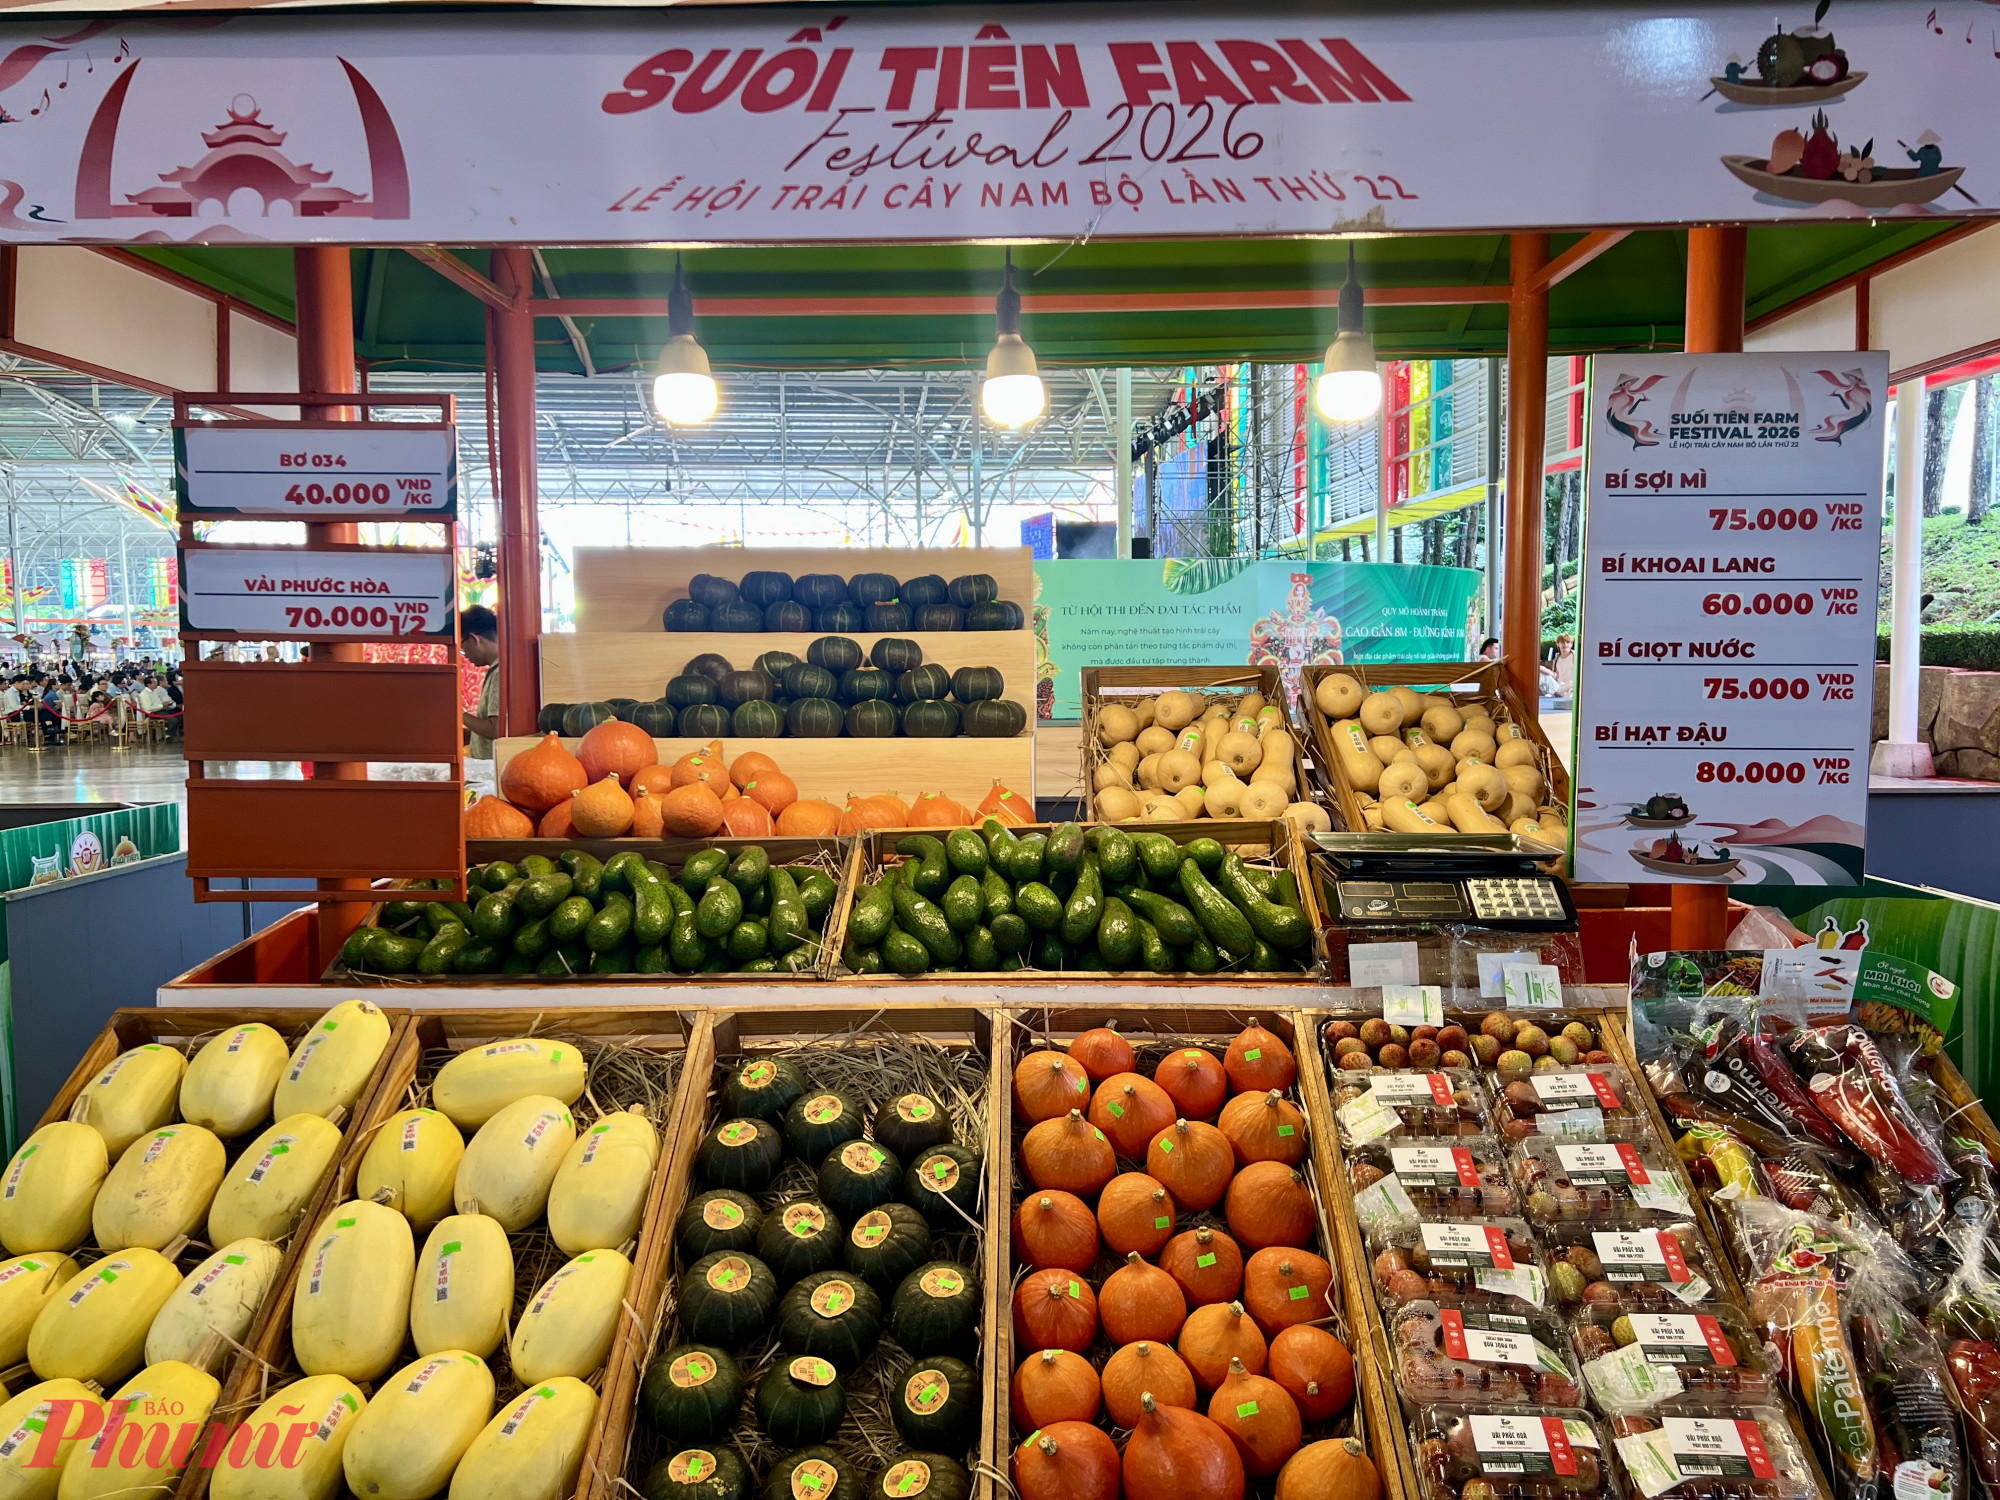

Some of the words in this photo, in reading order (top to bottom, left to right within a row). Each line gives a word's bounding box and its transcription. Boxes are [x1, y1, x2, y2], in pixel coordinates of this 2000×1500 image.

[601, 16, 854, 115] SUỐI
[879, 24, 1091, 112] TIÊN
[1107, 37, 1414, 106] FARM
[784, 106, 1072, 177] Festival
[1079, 100, 1264, 165] 2026
[607, 175, 685, 211] LỄ
[672, 179, 762, 218] HỘI
[771, 178, 868, 210] TRÁI
[883, 177, 961, 209] CÂY
[980, 181, 1069, 209] NAM
[1090, 173, 1144, 212] BỘ
[1160, 167, 1247, 204] LẦN
[1253, 169, 1346, 202] THỨ
[1353, 174, 1418, 200] 22
[1671, 409, 1708, 424] SUỐI
[1713, 410, 1749, 424] TIÊN
[1754, 413, 1799, 424] FARM
[1669, 427, 1753, 439] FESTIVAL
[1757, 427, 1800, 439] 2026
[1680, 441, 1692, 449] HỘI
[1746, 441, 1756, 449] BỘ
[280, 452, 307, 467] BƠ
[312, 454, 347, 467] 034
[1605, 469, 1630, 488] BÍ
[1634, 472, 1673, 493] SỢI
[1681, 468, 1707, 488] MÌ
[285, 483, 390, 505] 40.000
[396, 478, 432, 490] VND
[403, 492, 432, 506] /KG
[1709, 508, 1818, 531] 75.000
[1825, 503, 1863, 515] VND
[1831, 517, 1863, 532] /KG
[1602, 553, 1625, 573] BÍ
[1632, 557, 1705, 573] KHOAI
[1712, 557, 1776, 574] LANG
[244, 575, 276, 592] VẢI
[281, 576, 345, 594] PHƯỚC
[351, 575, 390, 594] HÒA
[1060, 605, 1077, 616] TỪ
[1081, 604, 1101, 617] HỘI
[1106, 606, 1126, 616] THI
[1129, 602, 1154, 615] ĐẾN
[1158, 606, 1179, 617] ĐẠI
[1182, 604, 1205, 615] TÁC
[1209, 602, 1241, 614] PHẨM
[1702, 593, 1814, 616] 60.000
[1820, 587, 1858, 600] VND
[1826, 602, 1858, 617] /KG
[285, 606, 388, 628] 70.000
[394, 602, 429, 614] VND
[1382, 607, 1396, 617] QUY
[1118, 628, 1138, 636] nghệ
[1345, 626, 1369, 638] CAO
[1394, 627, 1408, 637] 8M
[1599, 638, 1622, 658] BÍ
[1628, 642, 1683, 662] GIỌT
[1689, 638, 1756, 658] NƯỚC
[1703, 678, 1810, 700] 75.000
[1817, 673, 1855, 685] VND
[1822, 687, 1854, 701] /KG
[1595, 721, 1618, 742] BÍ
[1625, 726, 1671, 746] HẠT
[1677, 722, 1727, 746] ĐẬU
[1696, 761, 1806, 784] 80.000
[1813, 757, 1850, 770] VND
[1818, 772, 1850, 785] /KG
[1864, 970, 1889, 982] MAI
[1891, 975, 1921, 994] KHÔI
